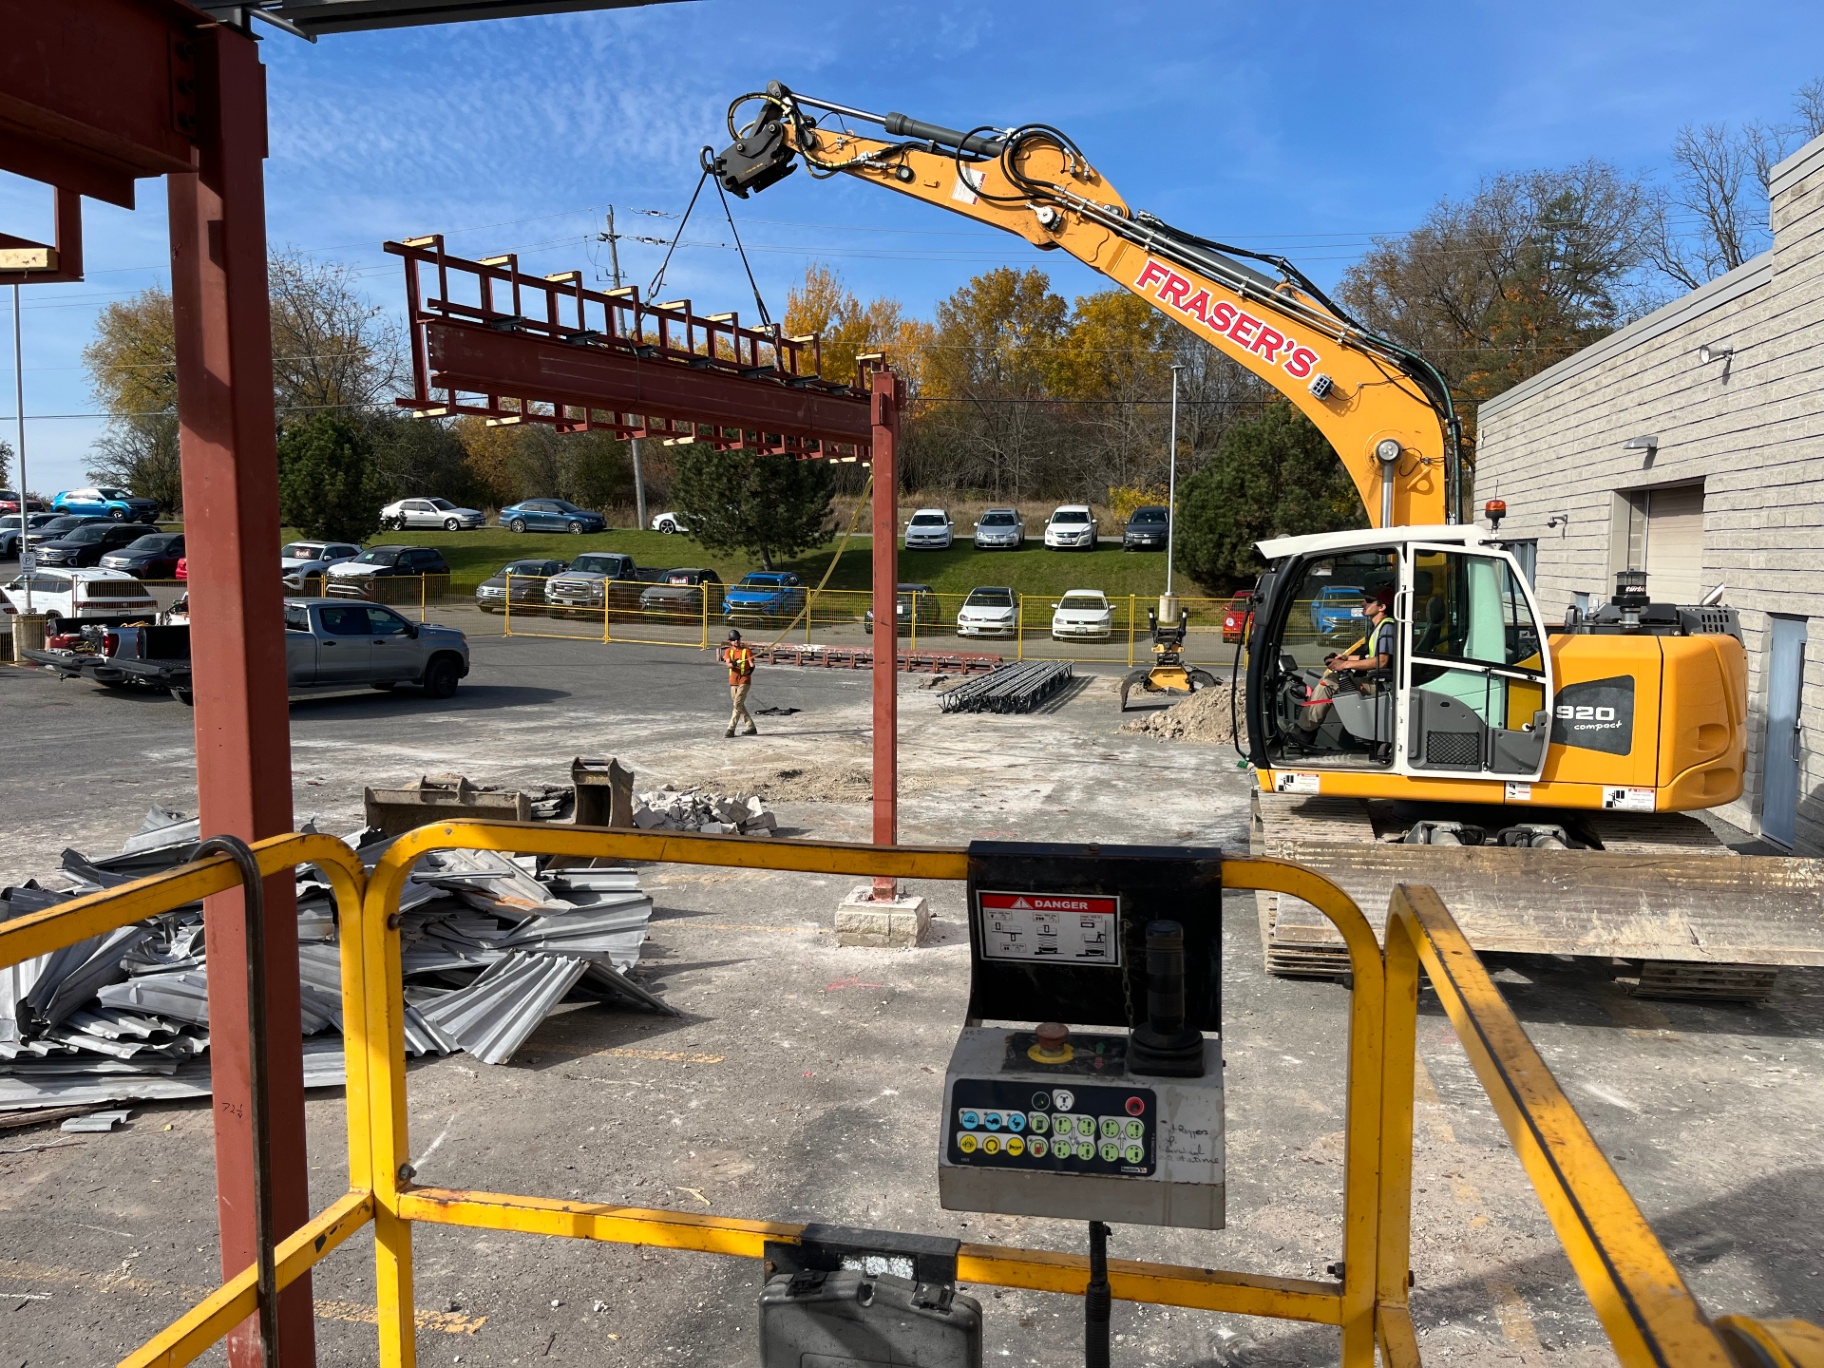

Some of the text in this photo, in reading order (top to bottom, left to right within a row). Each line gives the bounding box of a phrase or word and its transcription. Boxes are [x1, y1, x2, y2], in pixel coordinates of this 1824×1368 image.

[1135, 259, 1319, 378] FRASER'S
[1556, 705, 1615, 721] 920
[1573, 719, 1622, 732] compact
[1034, 900, 1089, 910] DANGER
